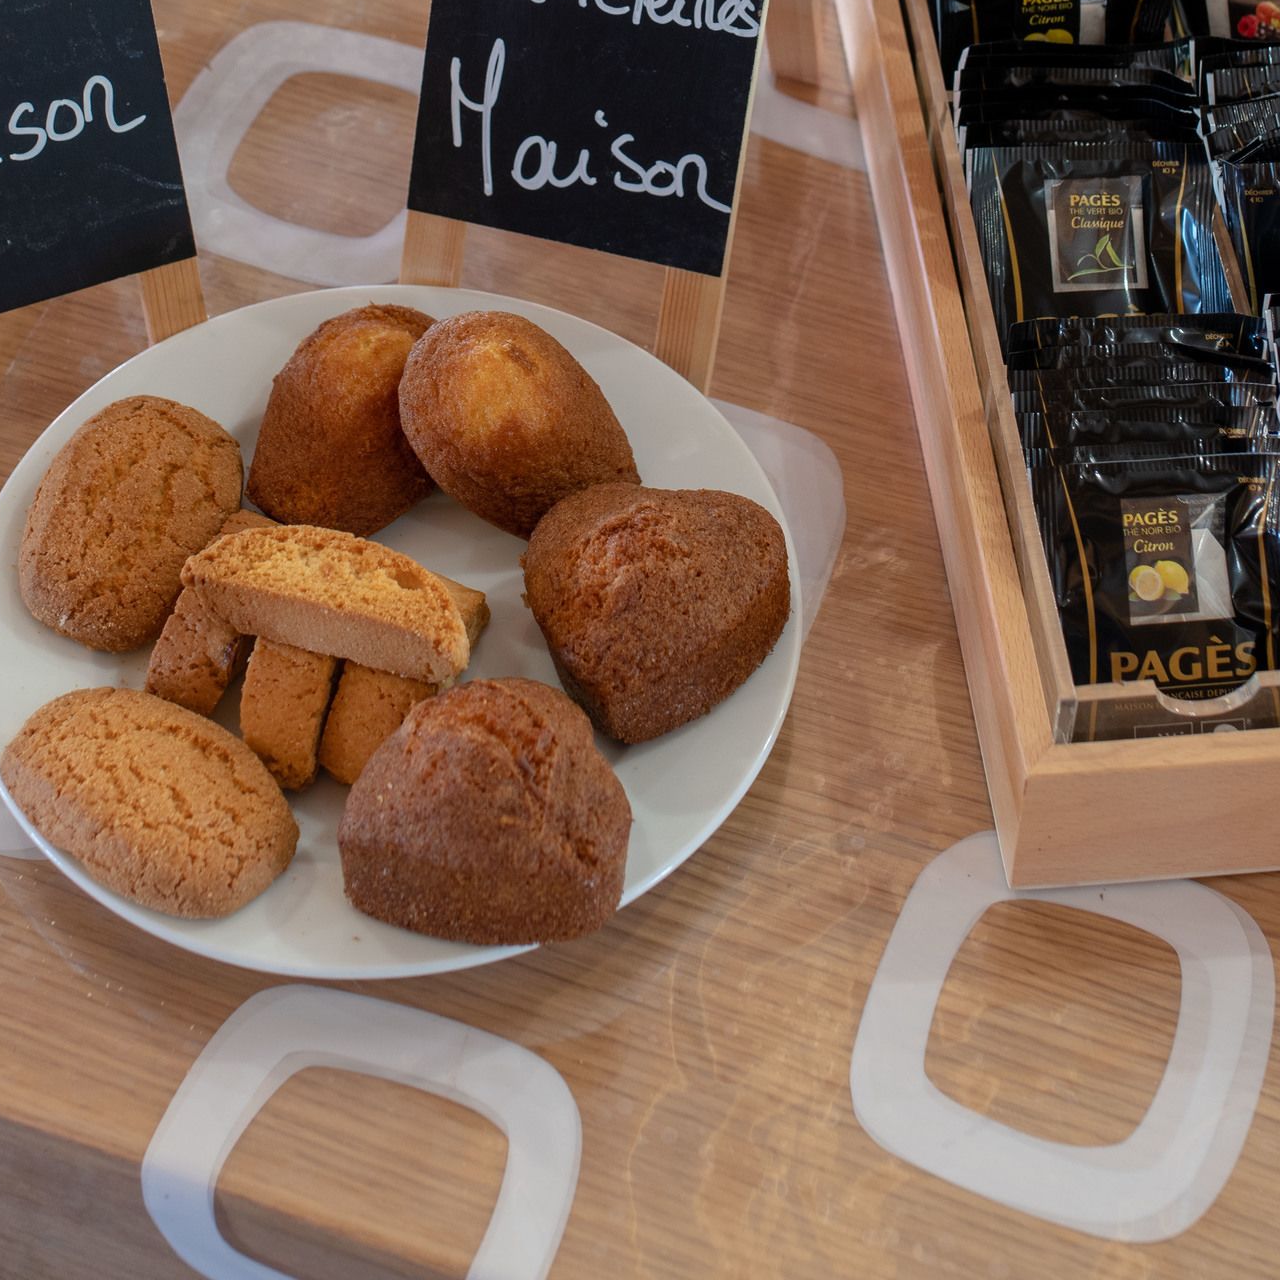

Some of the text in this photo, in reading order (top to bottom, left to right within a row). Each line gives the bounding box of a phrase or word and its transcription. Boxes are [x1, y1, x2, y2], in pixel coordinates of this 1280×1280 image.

[1038, 2, 1057, 13] NOIR
[1059, 1, 1073, 10] BIO
[1029, 13, 1065, 25] Citron
[450, 38, 732, 214] Maison
[1070, 192, 1121, 207] PAGÈS
[1087, 207, 1106, 215] VERT
[1108, 207, 1123, 215] BIO
[1071, 216, 1124, 231] Classique
[1122, 508, 1179, 527] PAGÈS
[1141, 526, 1164, 535] NOIR
[1165, 524, 1182, 534] BIO
[1133, 538, 1175, 553] Citron
[1110, 635, 1257, 684] PAGÈS
[1114, 703, 1153, 713] MAISON
